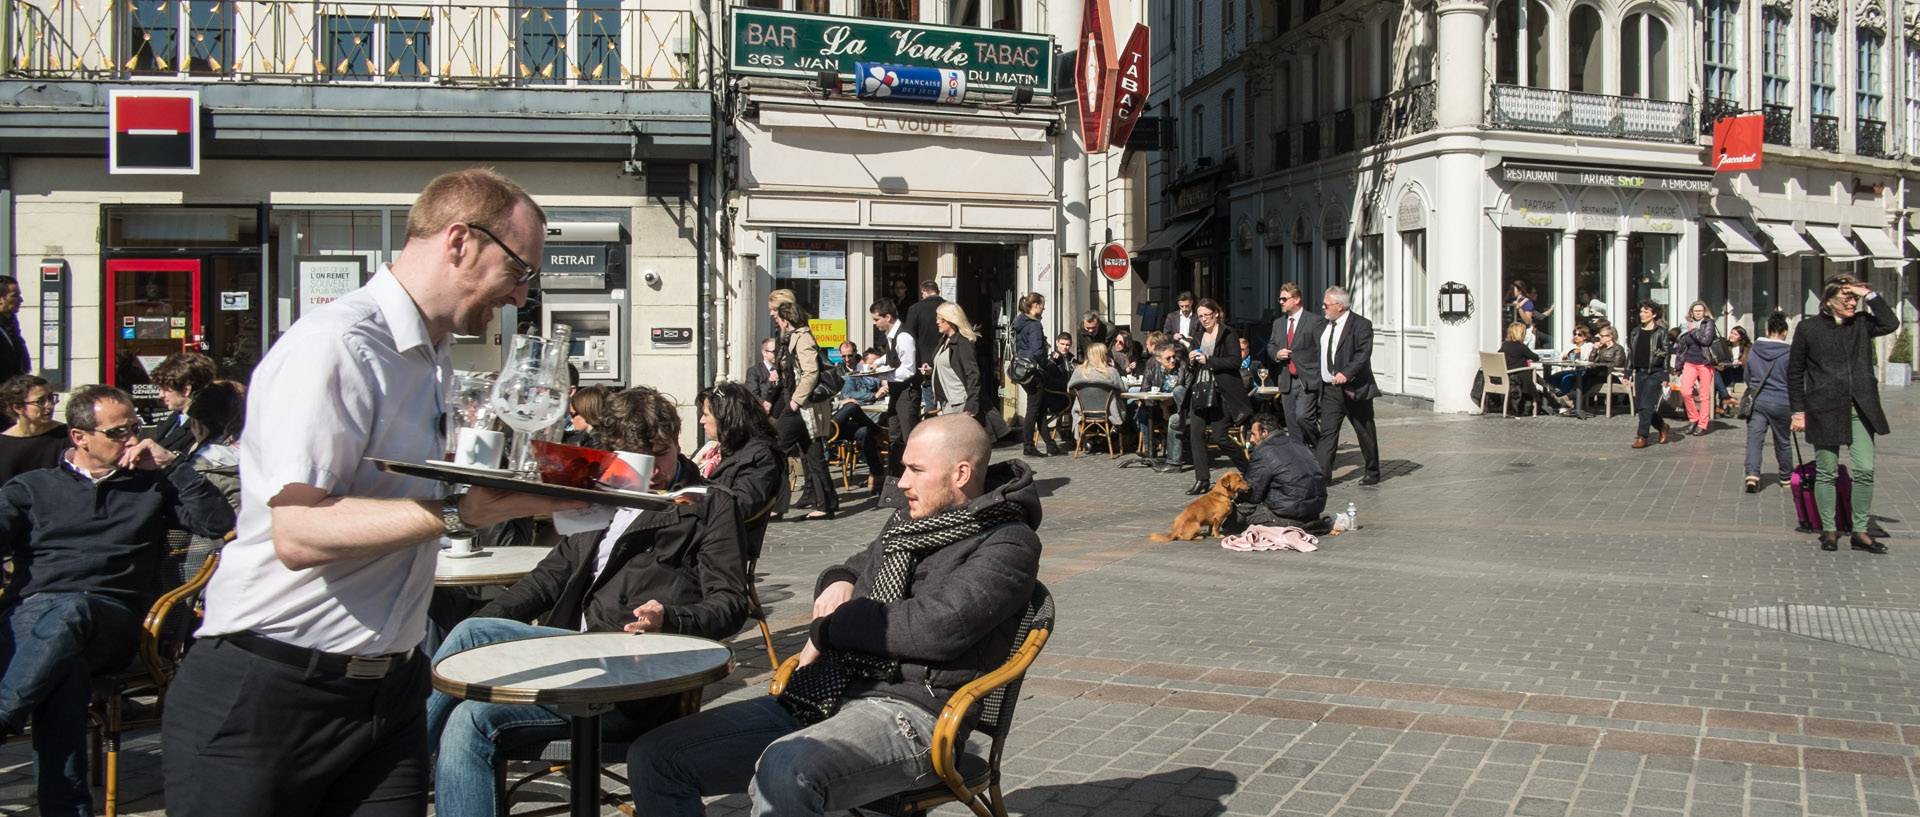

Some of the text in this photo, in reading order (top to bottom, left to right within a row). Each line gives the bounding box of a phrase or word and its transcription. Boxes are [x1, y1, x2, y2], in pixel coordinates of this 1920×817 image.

[748, 23, 1039, 68] BAR La Voute TABAC
[748, 54, 1038, 85] 365 J/AN DU MATIN
[901, 77, 941, 89] FRANÇAISE
[1118, 51, 1142, 120] TABAC
[902, 86, 937, 95] DES JEUX
[865, 116, 953, 133] LA VOUTE
[1506, 169, 1558, 181] RESTAURANT
[1580, 174, 1615, 185] TARTARE
[1669, 180, 1709, 191] EMPORTER
[1523, 199, 1557, 211] TARTARE
[1582, 205, 1618, 216] RESTAURANT
[1647, 205, 1676, 217] TARTARE
[550, 255, 596, 265] RETRAIT
[310, 272, 350, 280] L'ON REMET
[310, 280, 349, 288] SOUVENT
[811, 323, 833, 332] RETTE
[814, 334, 846, 342] RONIQUE
